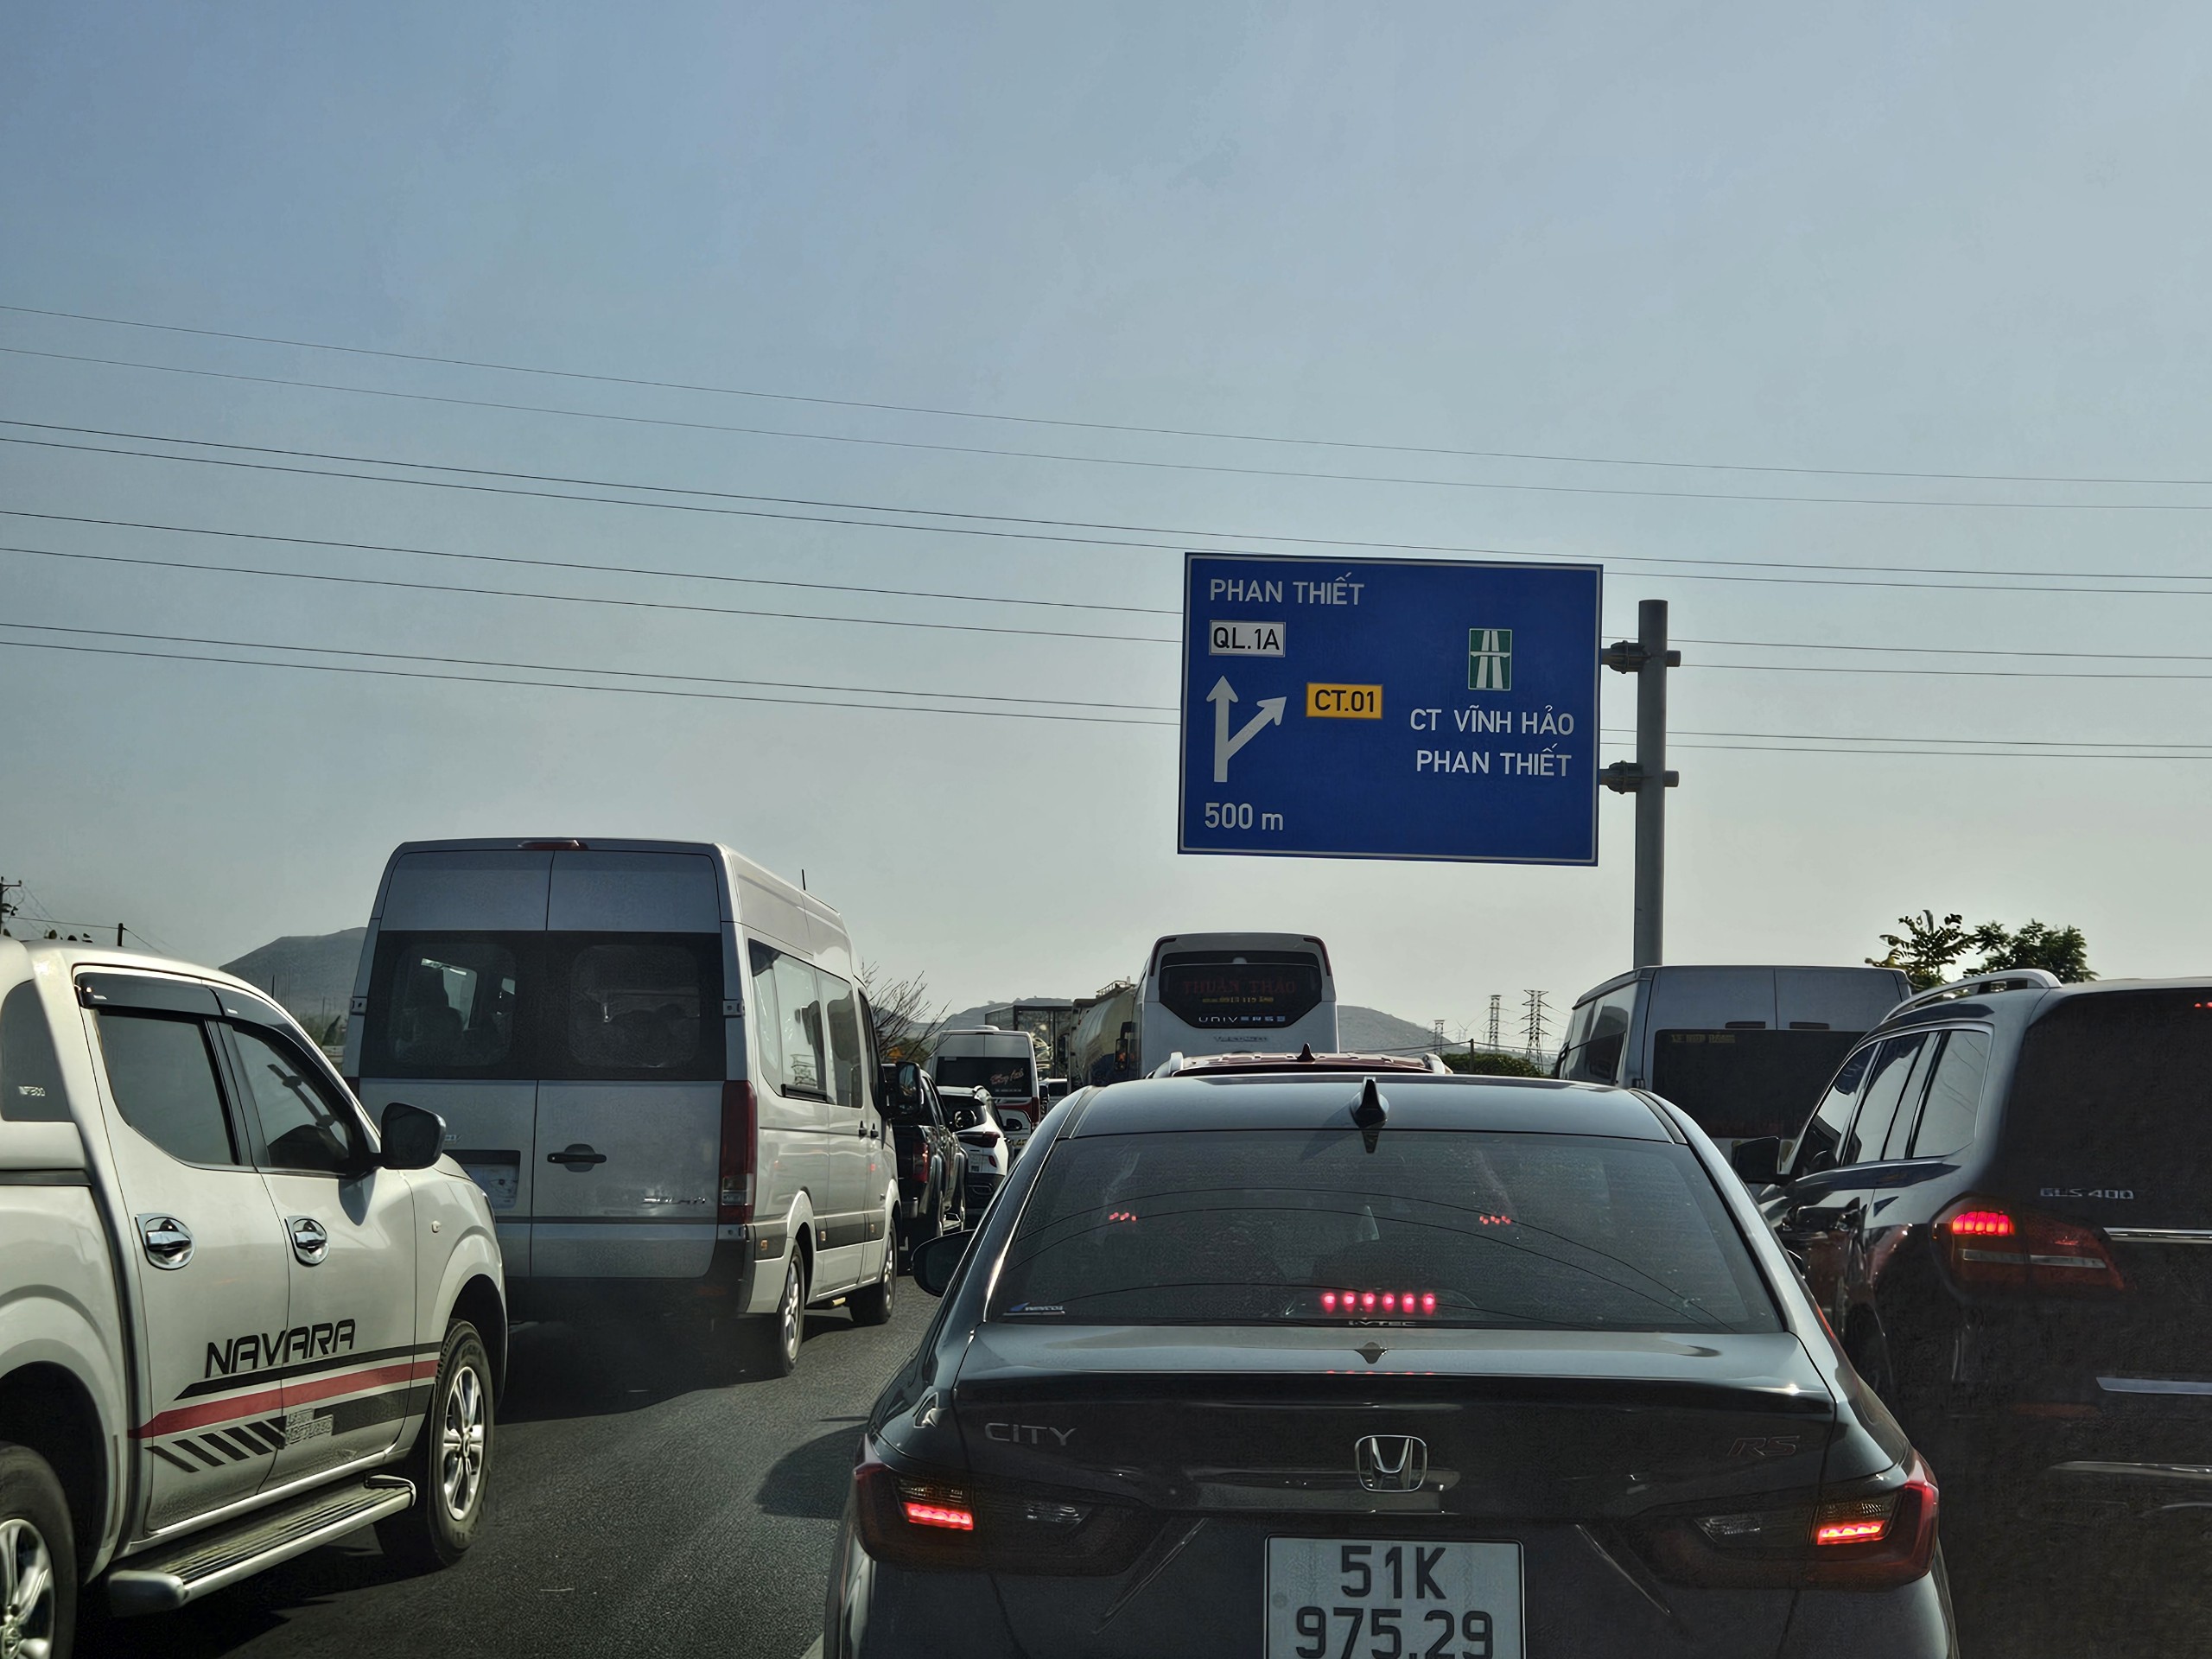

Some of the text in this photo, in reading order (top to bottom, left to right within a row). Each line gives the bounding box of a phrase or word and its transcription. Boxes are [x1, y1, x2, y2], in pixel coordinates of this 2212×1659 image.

[1210, 571, 1365, 606] PHAN THIẾT
[1213, 626, 1280, 651] QL.1A
[1314, 689, 1375, 713] CT.01
[1410, 704, 1574, 735] CT VĨNH HẢO
[1416, 743, 1573, 777] PHAN THIẾT
[1205, 802, 1284, 831] 500 m
[2040, 1187, 2134, 1199] GLS 400
[205, 1319, 356, 1378] NAVARA
[985, 1422, 1077, 1446] CITY
[1728, 1435, 1800, 1458] RS
[1341, 1545, 1446, 1599] 51K
[1296, 1605, 1494, 1659] 975.29
